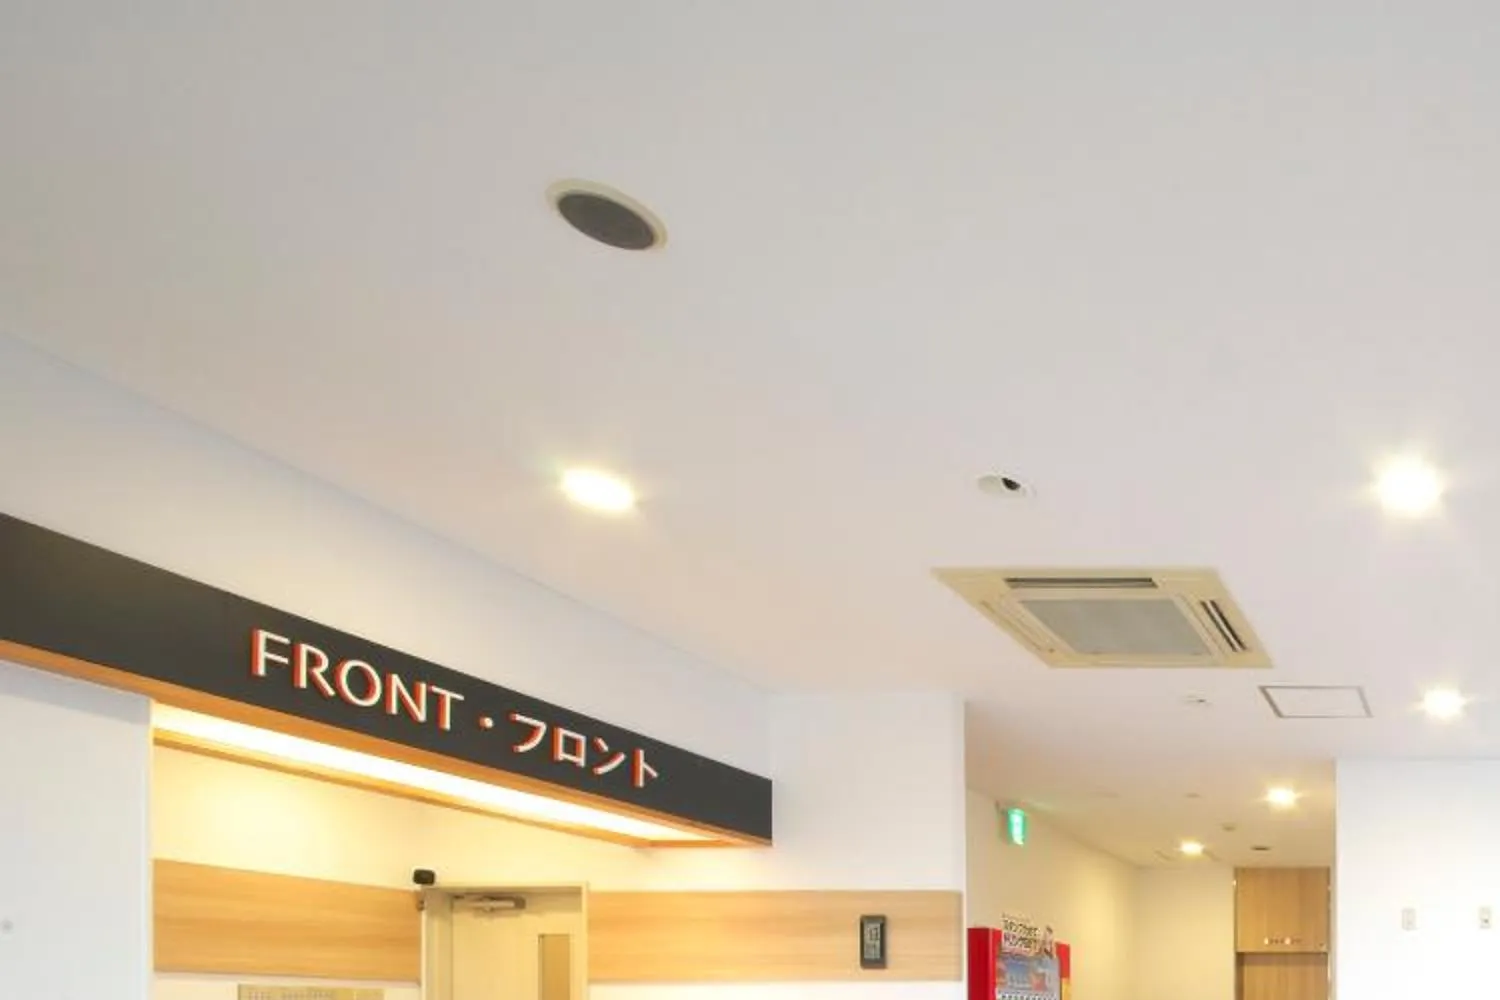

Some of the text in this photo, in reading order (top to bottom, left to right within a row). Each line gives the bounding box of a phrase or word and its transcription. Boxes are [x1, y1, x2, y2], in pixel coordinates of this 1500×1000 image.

[251, 628, 659, 788] FRONT フロント
